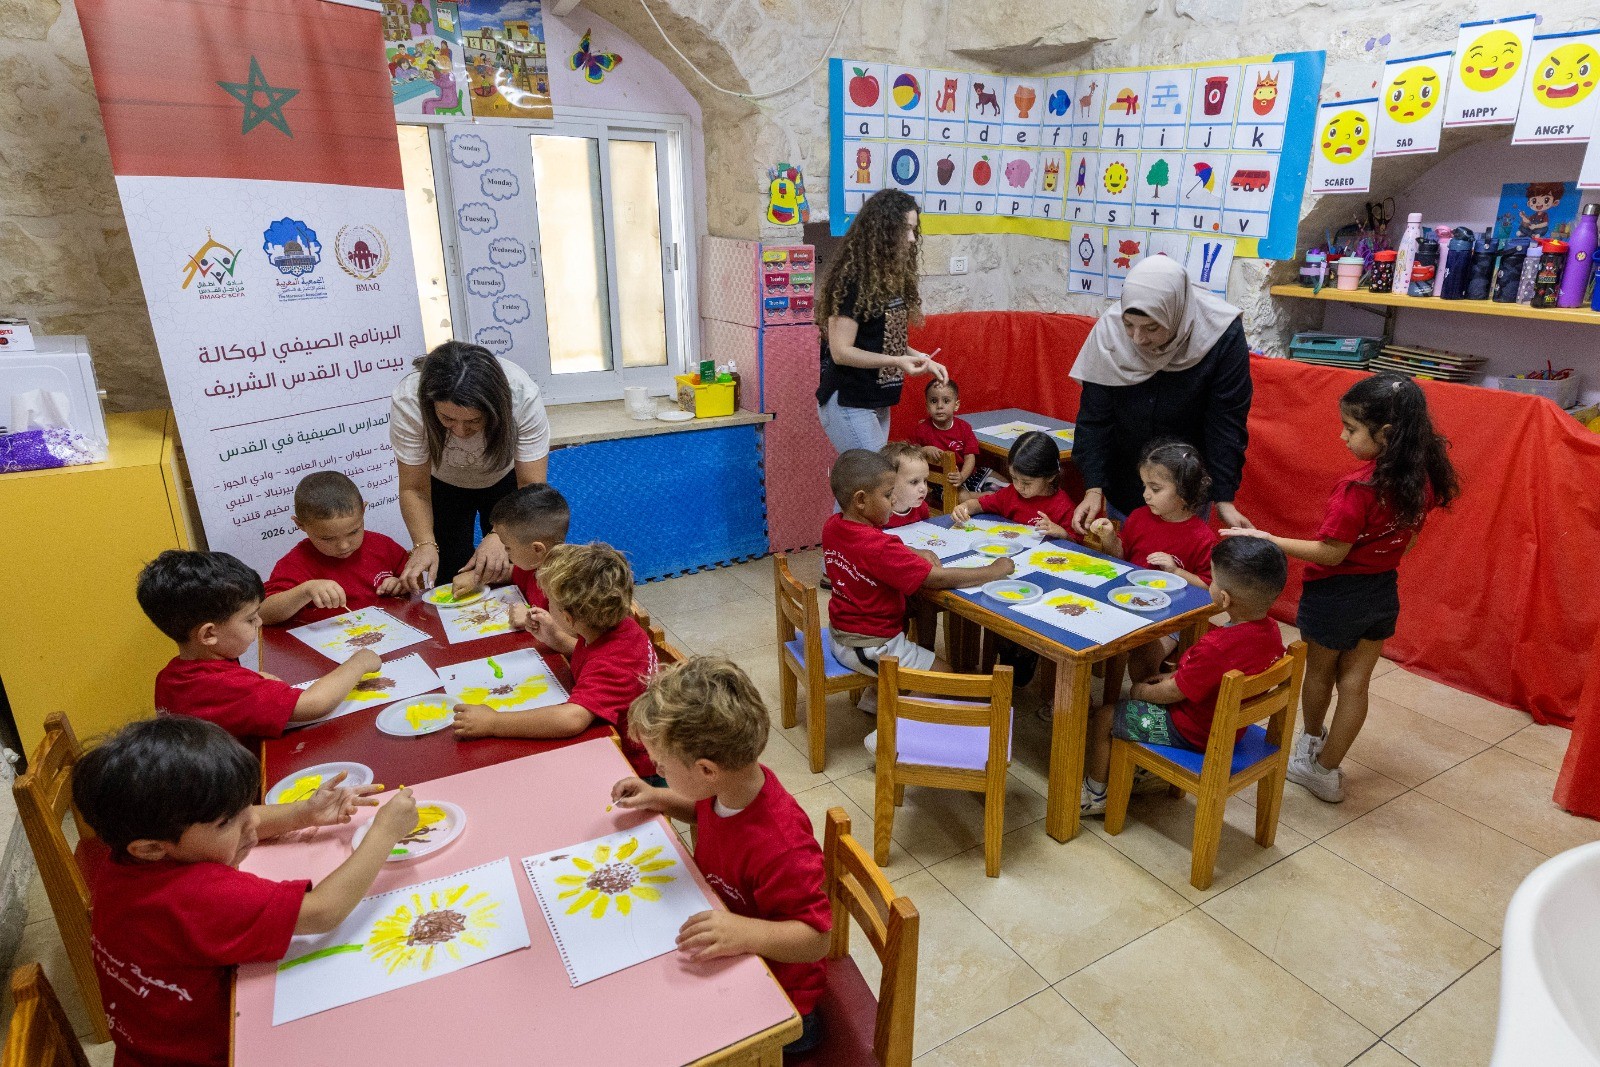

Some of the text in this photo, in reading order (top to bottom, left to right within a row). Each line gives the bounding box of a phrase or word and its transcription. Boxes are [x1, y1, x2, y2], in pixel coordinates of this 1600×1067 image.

[1462, 107, 1498, 118] HAPPY
[859, 119, 1264, 148] a b c d e f g h i j k
[1535, 124, 1574, 136] ANGRY
[458, 144, 482, 153] Sunday
[1396, 138, 1413, 148] SAD
[487, 178, 513, 187] Monday
[1324, 177, 1355, 187] SCARED
[464, 215, 490, 223] Tuesday
[938, 199, 947, 211] n
[975, 200, 983, 211] o
[1012, 200, 1019, 215] p
[1044, 204, 1050, 217] q
[1075, 206, 1081, 218] r
[1108, 210, 1116, 222] s
[1151, 208, 1160, 225] t
[1194, 215, 1203, 229] u
[1239, 219, 1249, 232] v
[491, 246, 523, 254] Wednesday
[356, 283, 381, 292] BMAQ
[472, 279, 502, 287] Thursday
[1081, 278, 1092, 291] w
[502, 304, 520, 312] Friday
[199, 325, 401, 364] البرنامج الصيفي لوكالة
[480, 338, 508, 346] Saturday
[204, 357, 404, 400] بيت مال القدس الشريف
[219, 413, 391, 462] المدارس الصيفية في القدس
[346, 449, 371, 461] سلوان
[284, 460, 317, 476] العامود
[367, 463, 382, 472] بيت
[223, 476, 247, 491] الجوز
[250, 471, 273, 485] وادي
[226, 494, 253, 511] النبي
[233, 475, 393, 527] الجديرة مخيم قلنديا
[261, 526, 286, 541] 2026
